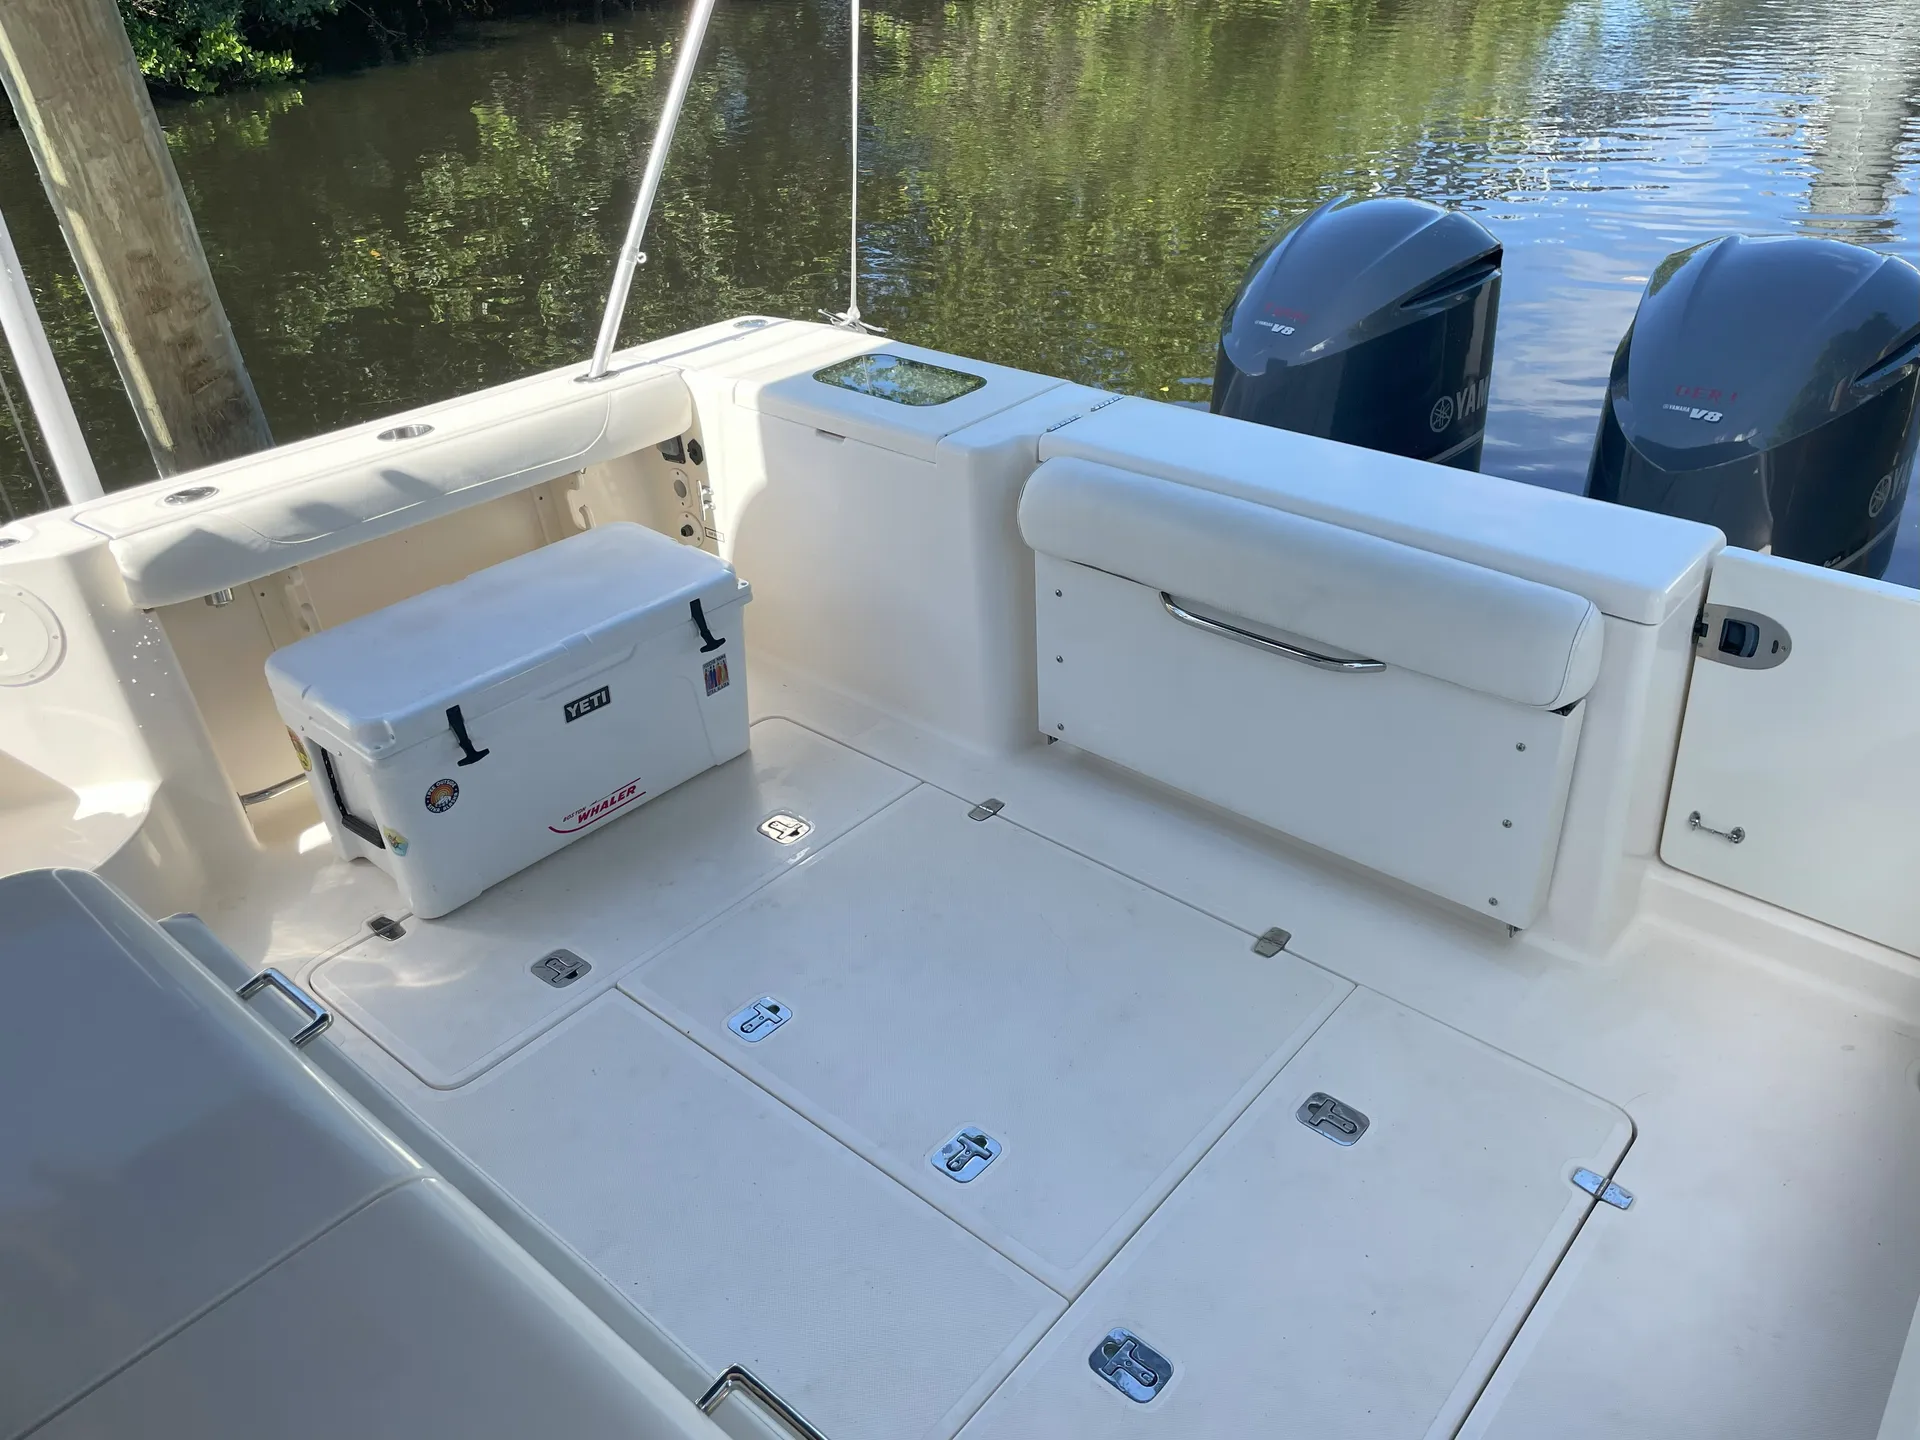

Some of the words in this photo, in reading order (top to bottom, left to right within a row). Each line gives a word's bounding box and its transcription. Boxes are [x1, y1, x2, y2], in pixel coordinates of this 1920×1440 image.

[1271, 323, 1295, 335] V8
[1668, 404, 1690, 412] YAMAHA
[1690, 408, 1723, 422] V8
[566, 690, 607, 718] YETI
[578, 784, 637, 824] WHALER
[563, 806, 587, 823] BOSTON
